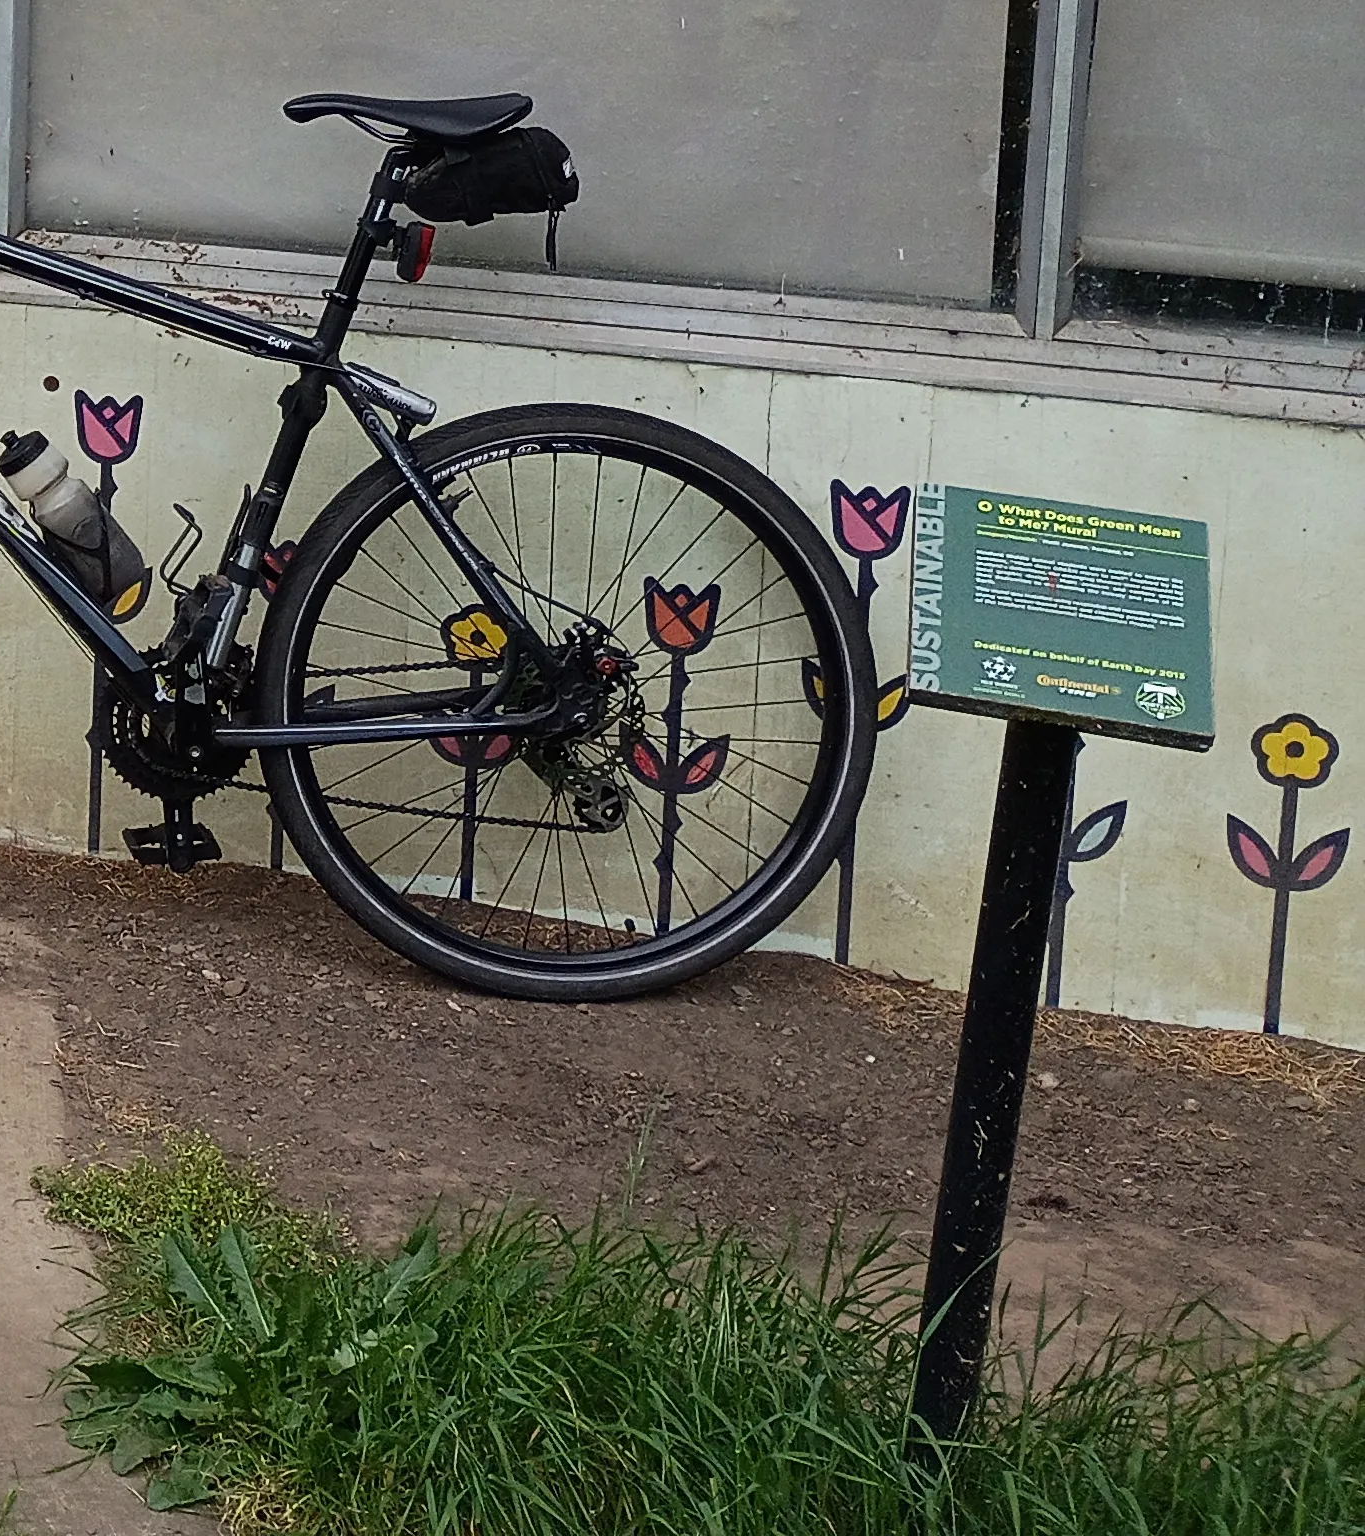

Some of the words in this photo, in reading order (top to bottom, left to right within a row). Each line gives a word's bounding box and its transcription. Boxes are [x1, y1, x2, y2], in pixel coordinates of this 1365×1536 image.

[998, 515, 1016, 527] to
[1019, 518, 1049, 532] Me?
[1053, 524, 1097, 538] Mural
[999, 503, 1041, 519] What
[1045, 510, 1084, 525] Does
[1088, 516, 1134, 533] Green
[1138, 521, 1181, 538] Mean
[910, 482, 946, 693] SUSTAINABLE
[974, 640, 1030, 656] Dedicated
[1033, 650, 1047, 658] on
[1050, 651, 1084, 664] behalf
[1087, 658, 1099, 667] of
[1102, 660, 1132, 672] Earth
[1134, 665, 1157, 676] Day
[1037, 674, 1110, 695] Continental
